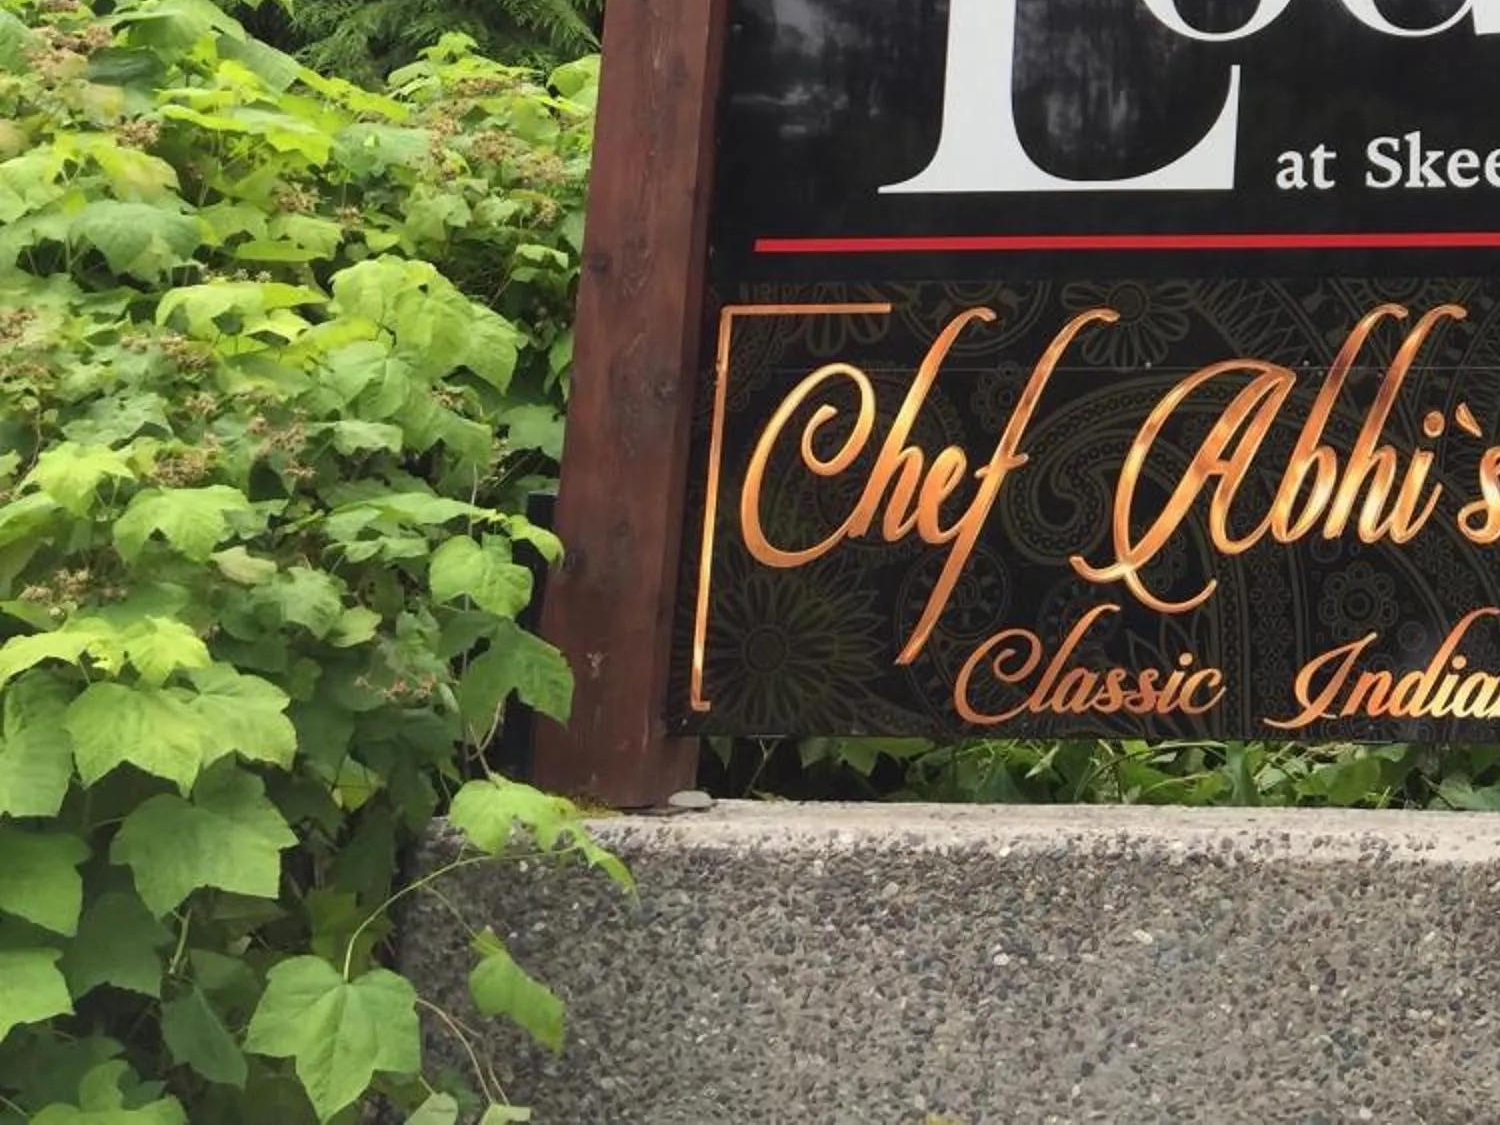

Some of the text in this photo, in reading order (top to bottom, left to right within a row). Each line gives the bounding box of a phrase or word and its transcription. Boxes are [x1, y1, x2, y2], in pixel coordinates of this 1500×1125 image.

[1276, 143, 1334, 191] at
[740, 306, 1119, 665] Chef
[954, 605, 1226, 725] Classic
